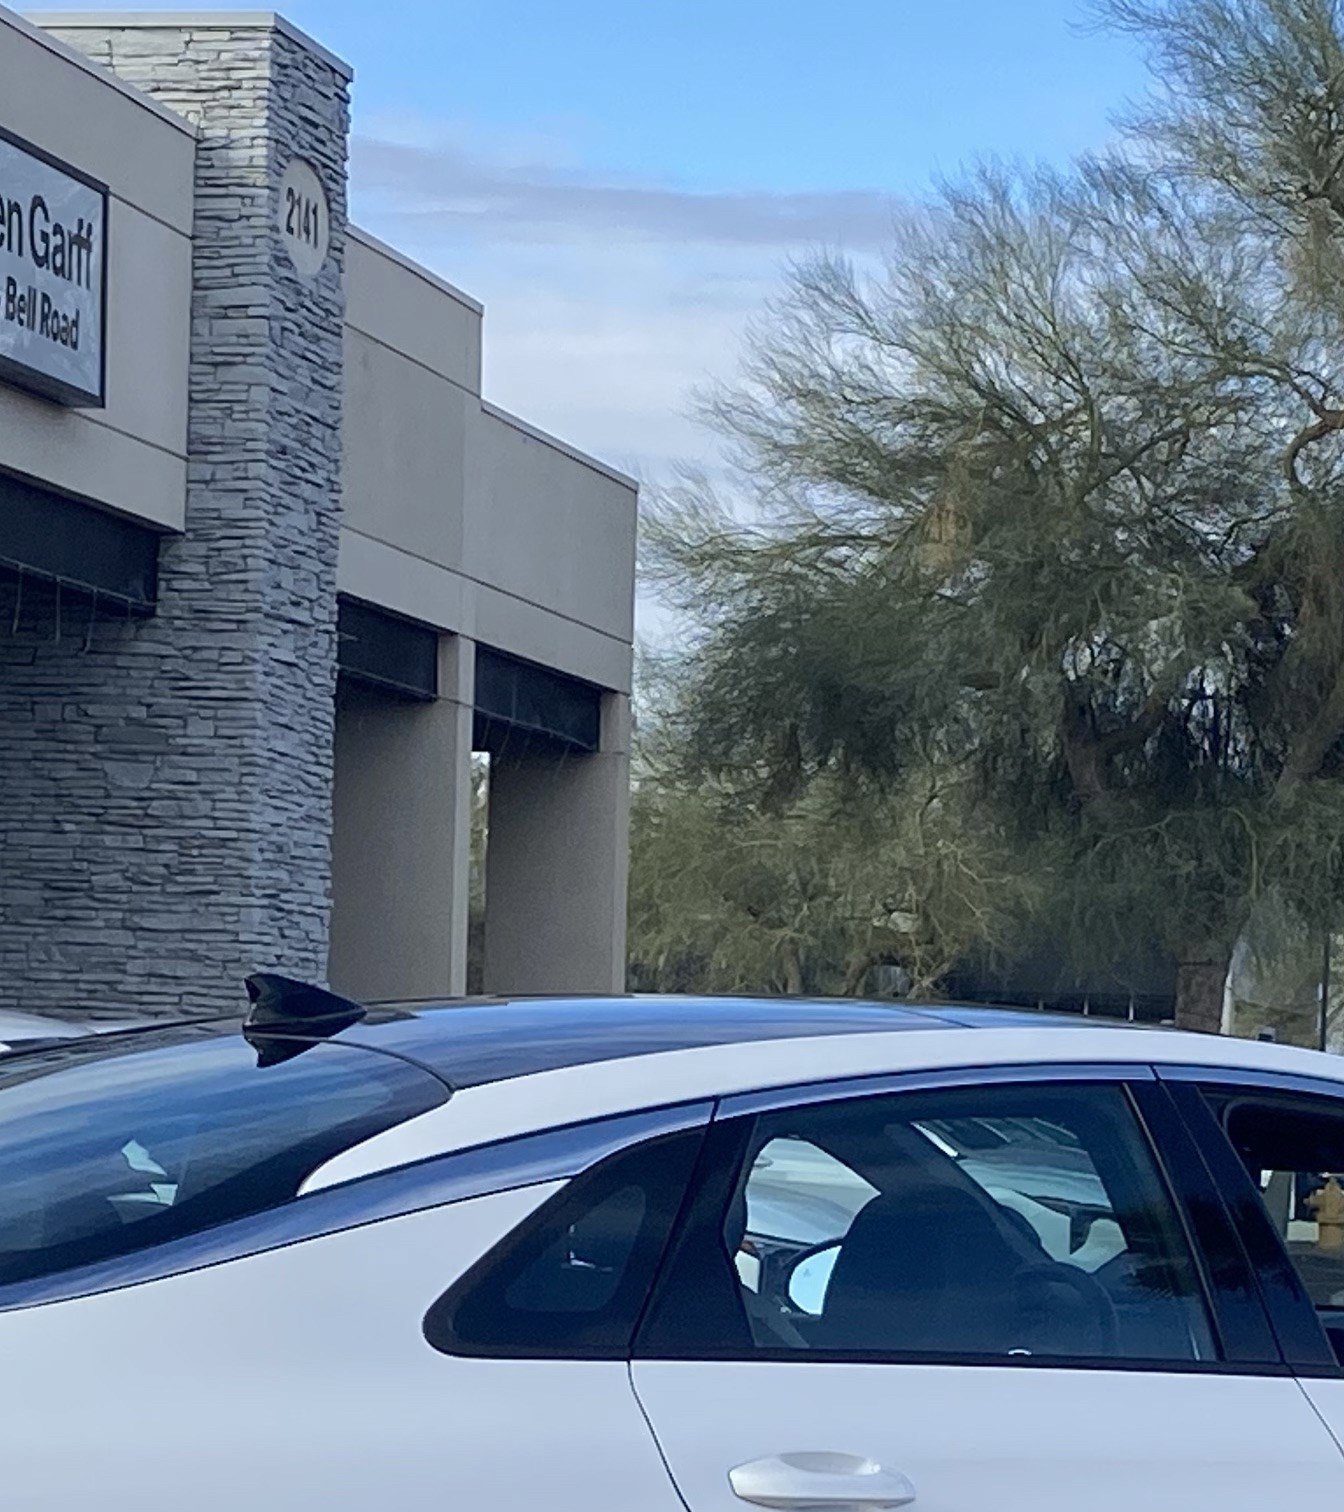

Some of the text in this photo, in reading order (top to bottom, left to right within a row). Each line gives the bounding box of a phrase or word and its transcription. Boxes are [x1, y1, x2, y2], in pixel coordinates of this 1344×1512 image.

[29, 194, 92, 290] Garff
[286, 186, 318, 249] 2141
[6, 275, 37, 332] Bell
[40, 291, 80, 351] Road
